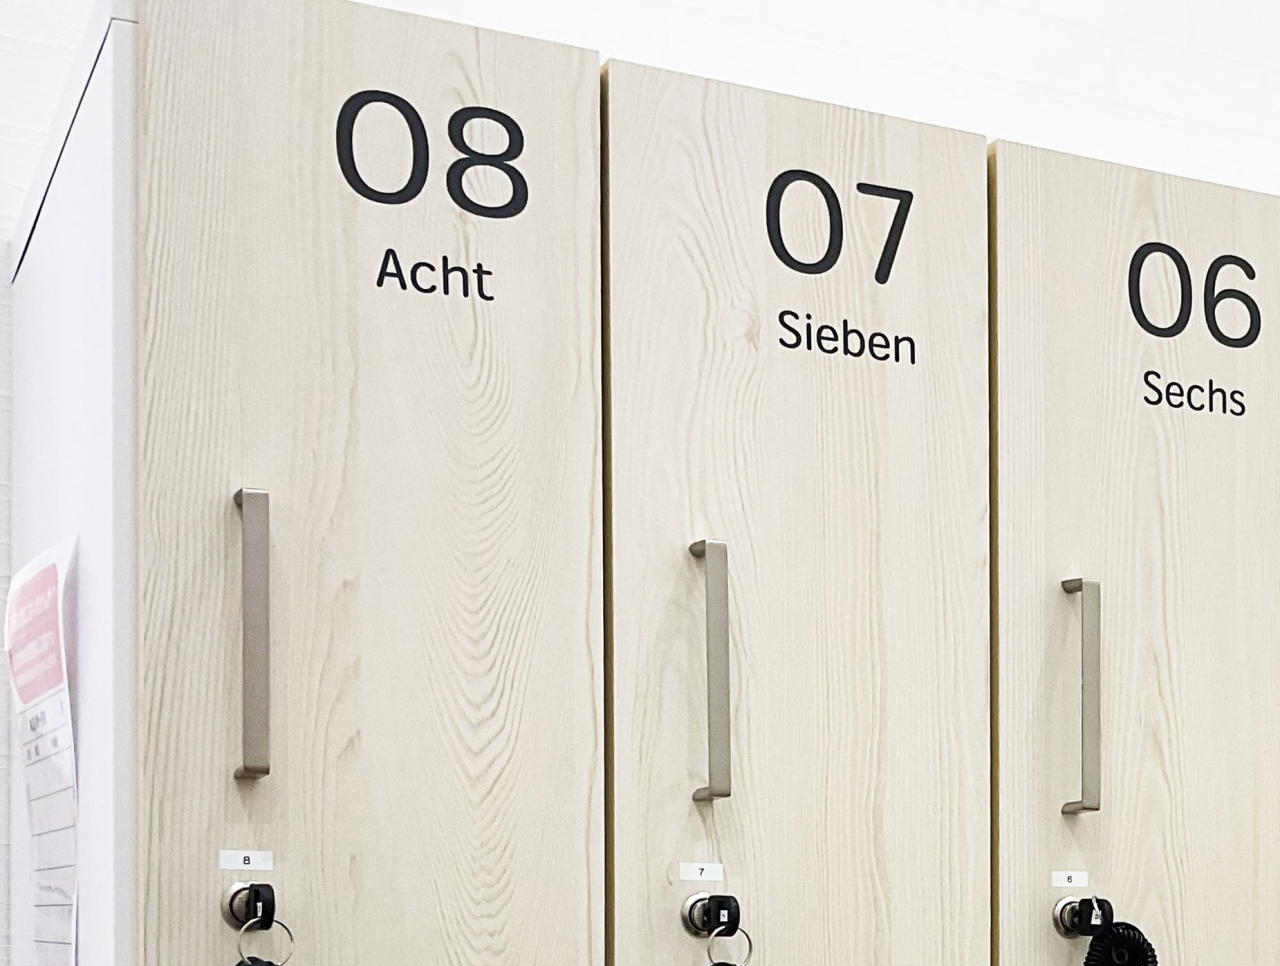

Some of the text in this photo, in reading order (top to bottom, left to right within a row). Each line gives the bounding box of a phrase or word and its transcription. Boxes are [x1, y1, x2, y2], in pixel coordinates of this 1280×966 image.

[335, 89, 529, 219] 08
[765, 169, 914, 285] 07
[376, 248, 495, 302] Acht
[1127, 241, 1262, 349] 06
[778, 310, 916, 365] Sieben
[1143, 370, 1246, 417] Sechs
